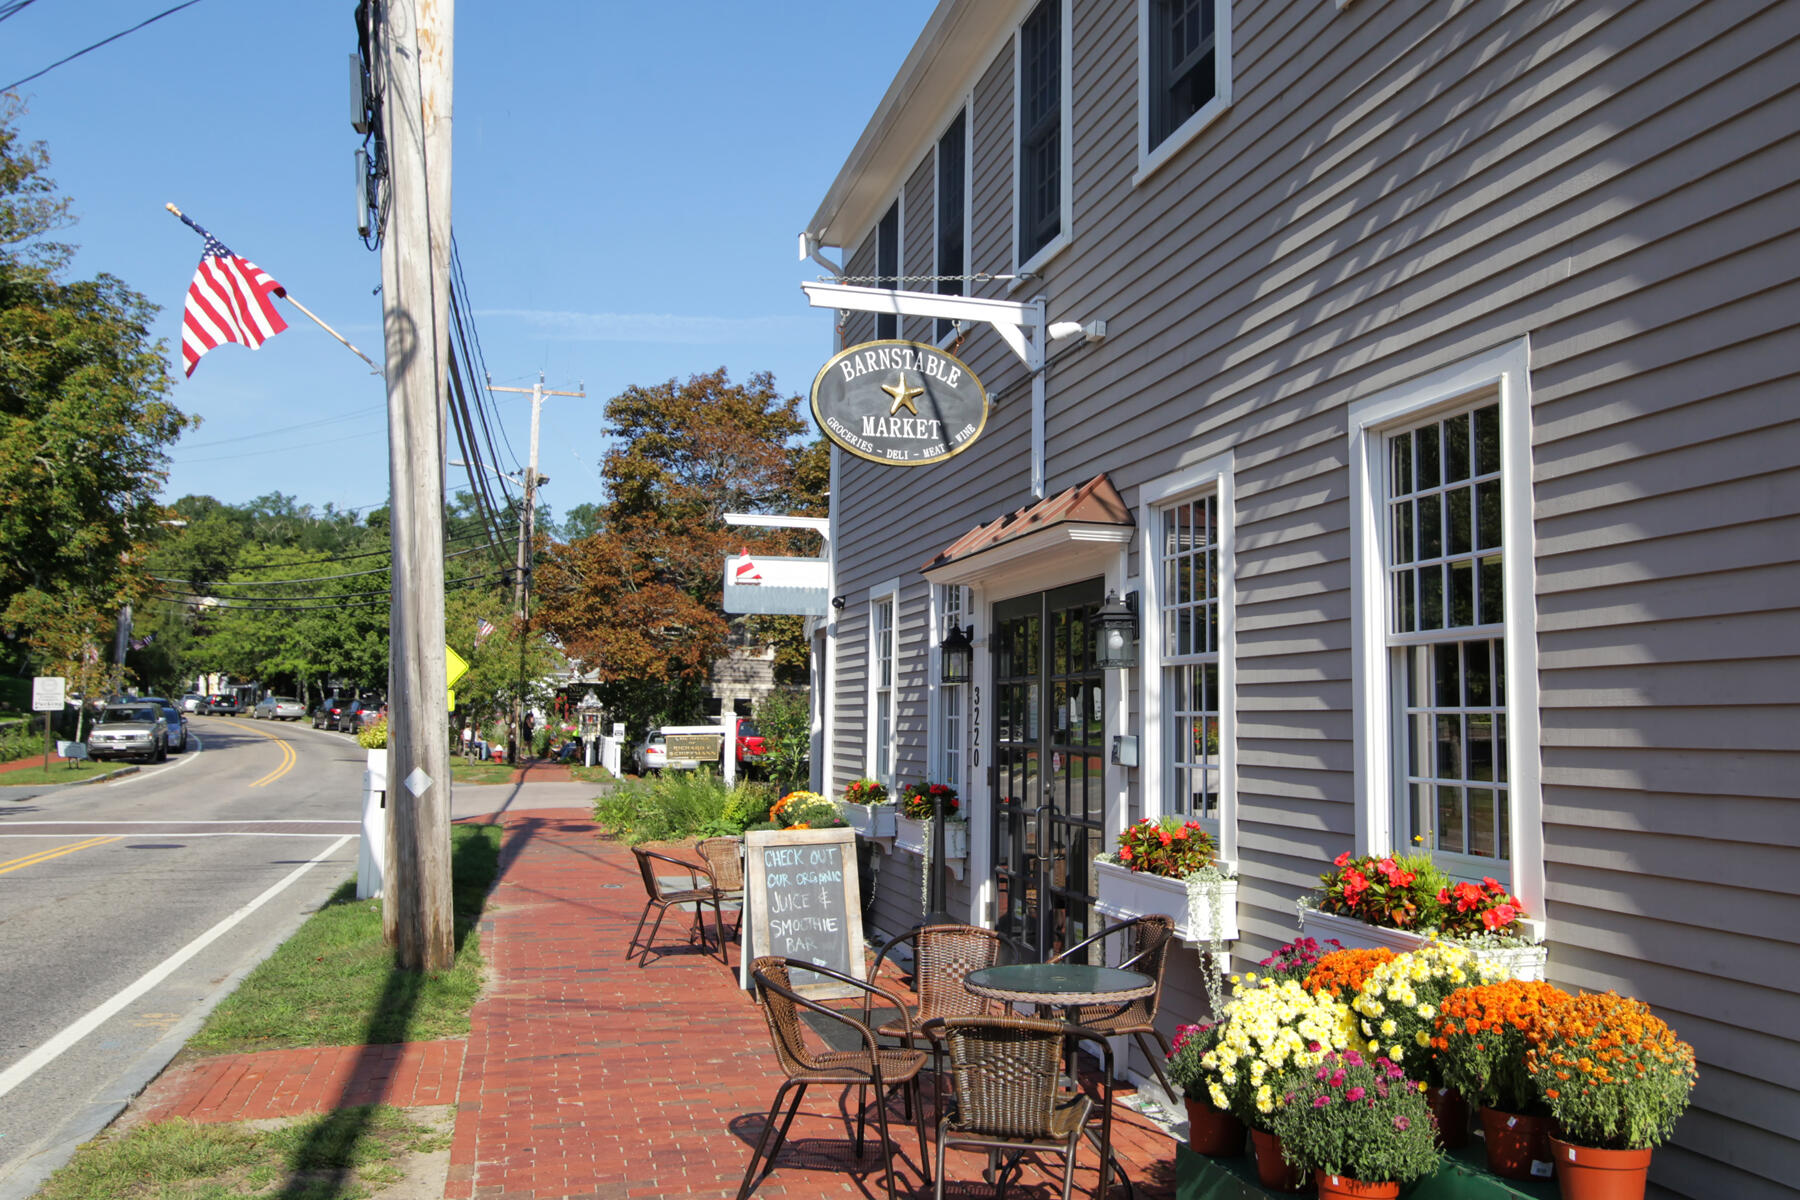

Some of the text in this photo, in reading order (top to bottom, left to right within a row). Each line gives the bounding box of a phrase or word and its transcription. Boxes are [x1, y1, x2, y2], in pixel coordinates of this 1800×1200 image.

[840, 348, 962, 388] BARNSTABLE
[827, 416, 873, 453] GROCERIES
[886, 450, 908, 460] DELI
[923, 444, 945, 458] MEAT
[955, 423, 976, 442] WINE
[862, 416, 941, 439] MARKET
[764, 848, 838, 867] CHECK OUT
[767, 870, 842, 888] OUR ORGANIC
[772, 891, 811, 913] JUICE
[770, 917, 838, 938] SMOOTHIE
[786, 937, 817, 953] BAR
